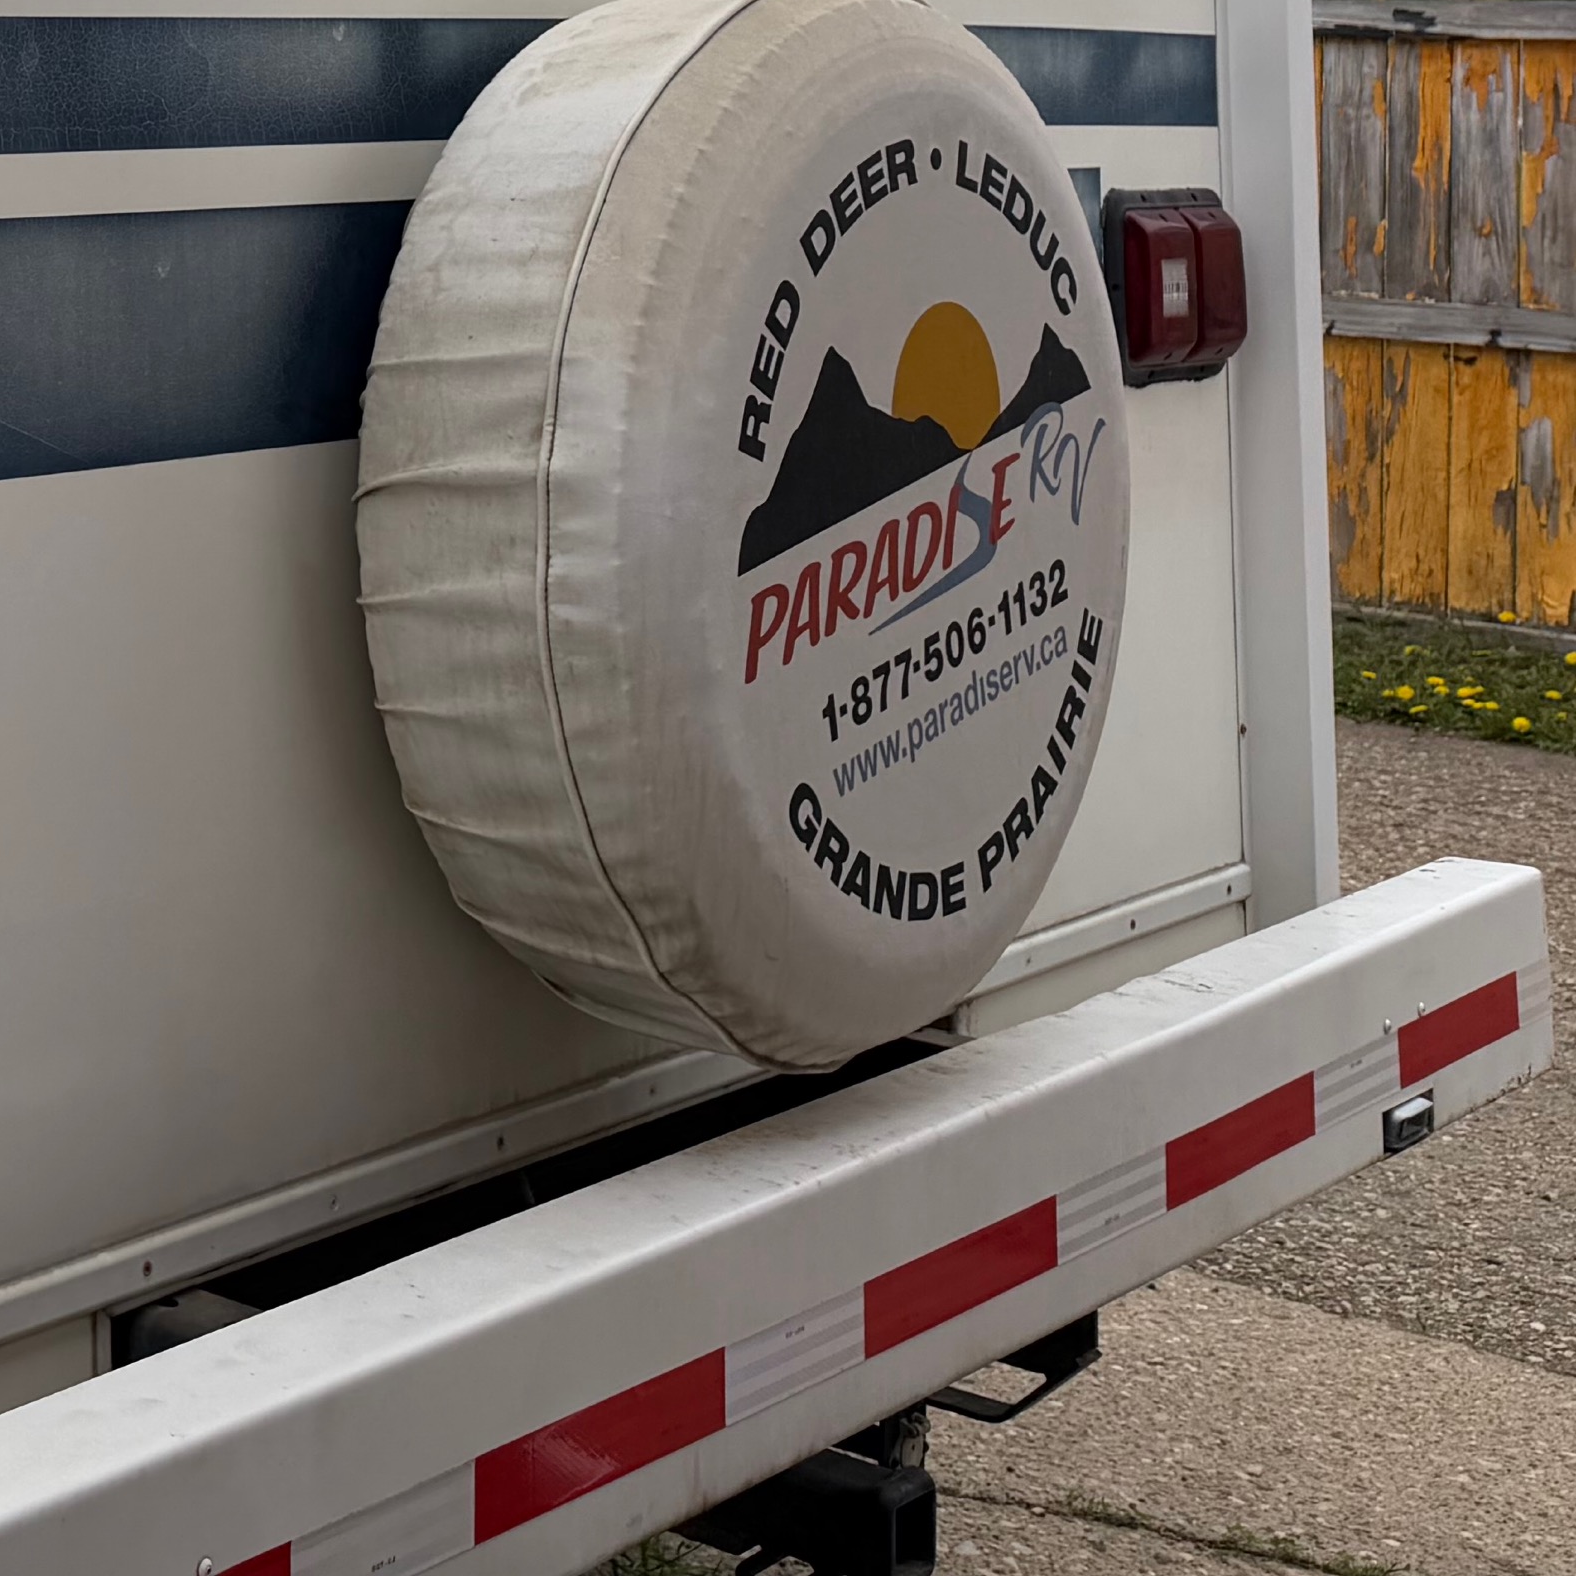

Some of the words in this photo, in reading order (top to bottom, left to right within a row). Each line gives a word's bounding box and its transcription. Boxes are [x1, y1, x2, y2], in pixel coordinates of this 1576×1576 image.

[738, 280, 801, 462] RED
[799, 139, 919, 277] DEER
[957, 139, 1078, 316] LEDUC
[744, 451, 1021, 684] PARADISE
[1021, 402, 1106, 526] RV
[822, 558, 1069, 742] 1-877-506-1132
[788, 782, 966, 921] GRANDE
[977, 607, 1104, 893] PRAIRIE
[833, 625, 1068, 797] www.paradiserv.ca
